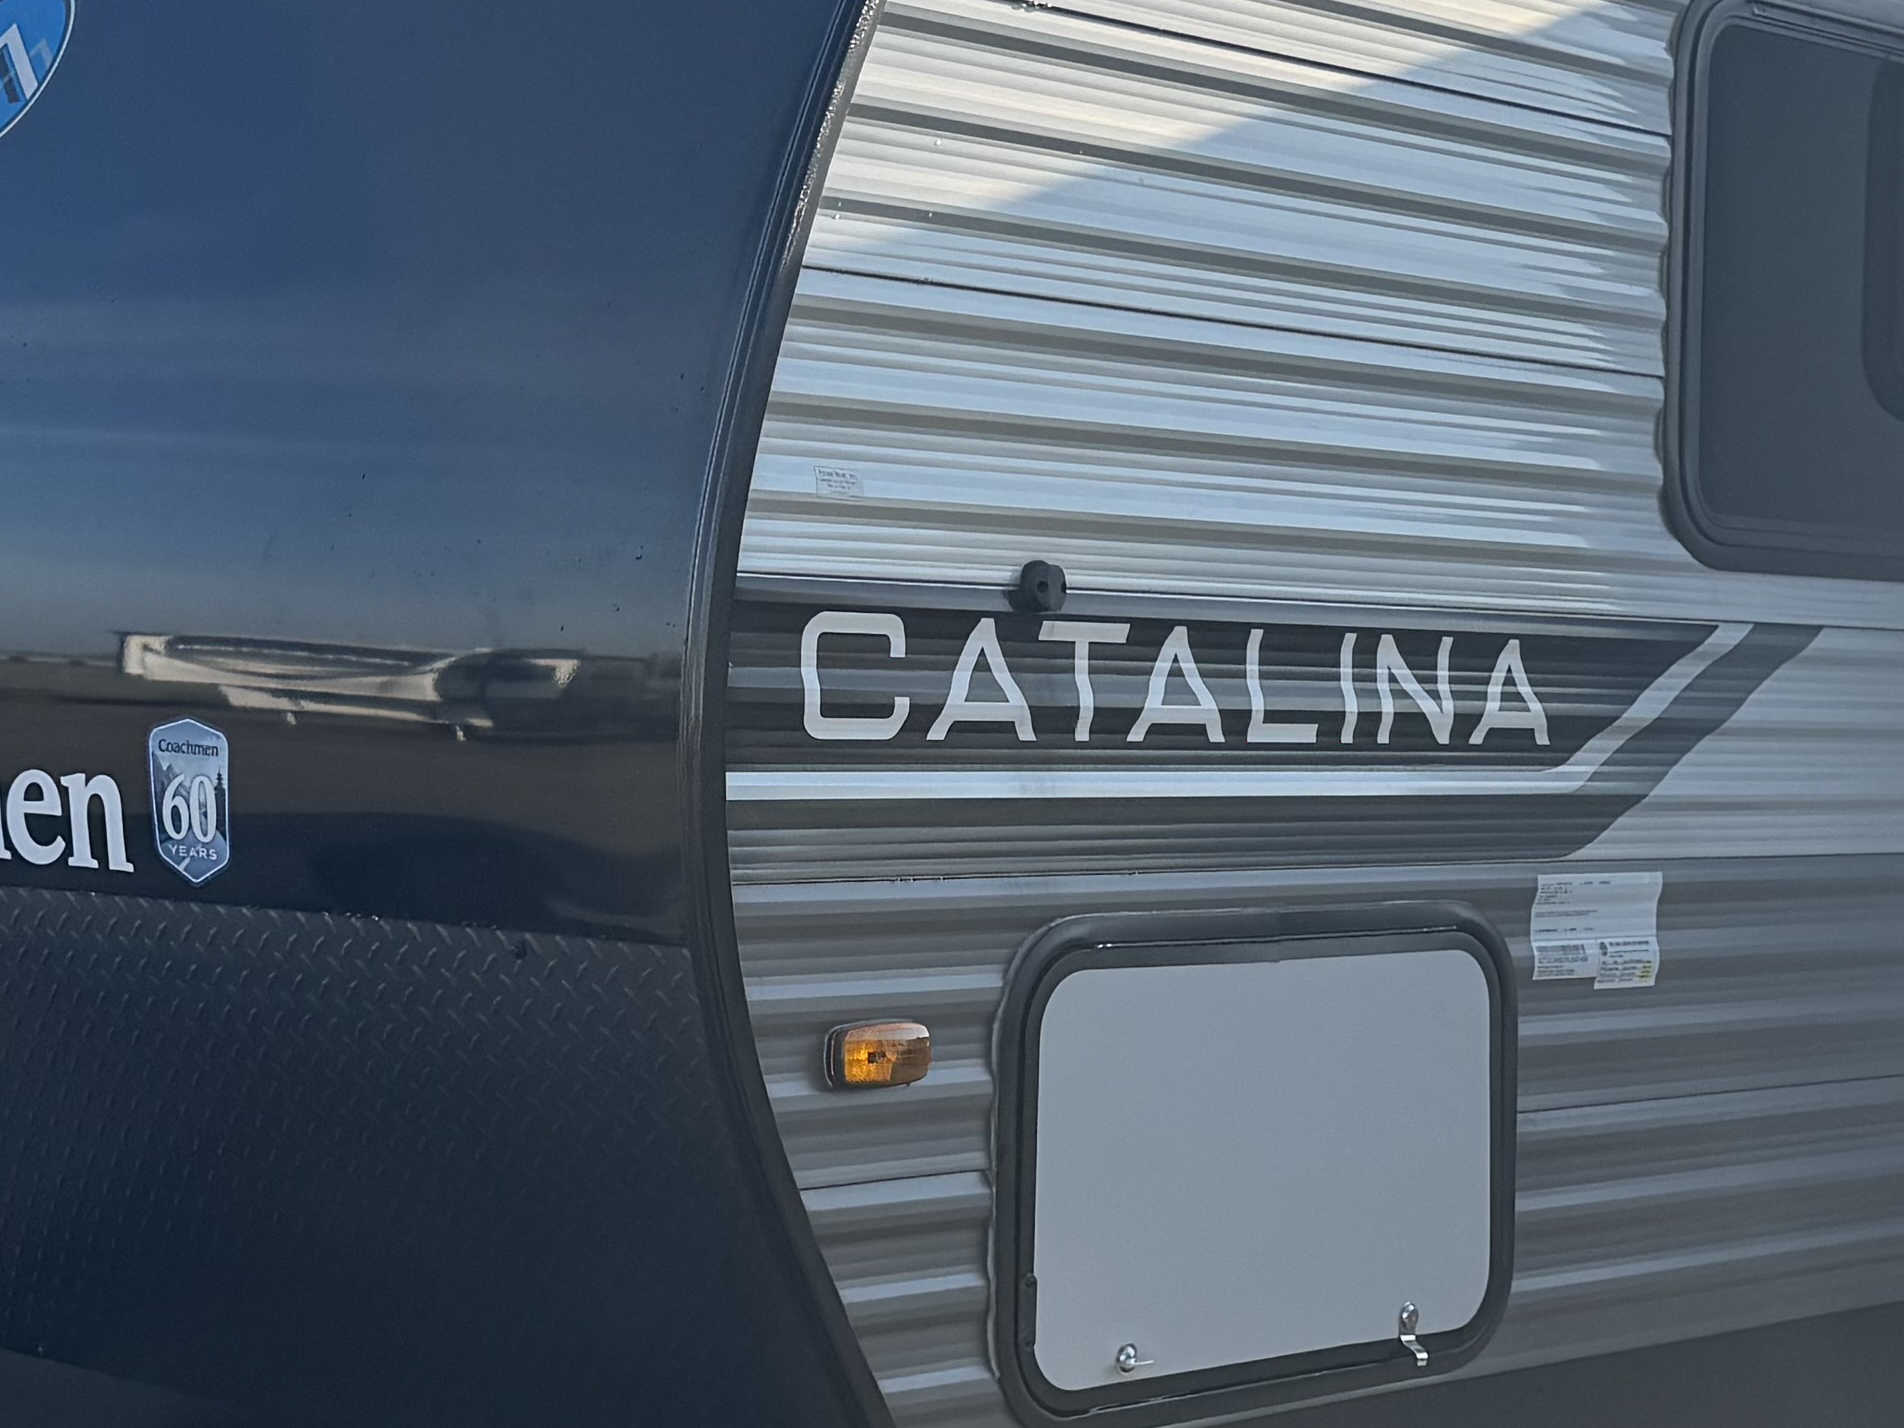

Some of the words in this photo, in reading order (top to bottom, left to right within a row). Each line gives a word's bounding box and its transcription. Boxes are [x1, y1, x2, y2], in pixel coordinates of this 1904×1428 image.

[799, 611, 1551, 747] CATALINA
[158, 738, 219, 757] Coachmen
[162, 773, 217, 843] 60
[169, 844, 218, 861] YEARS
